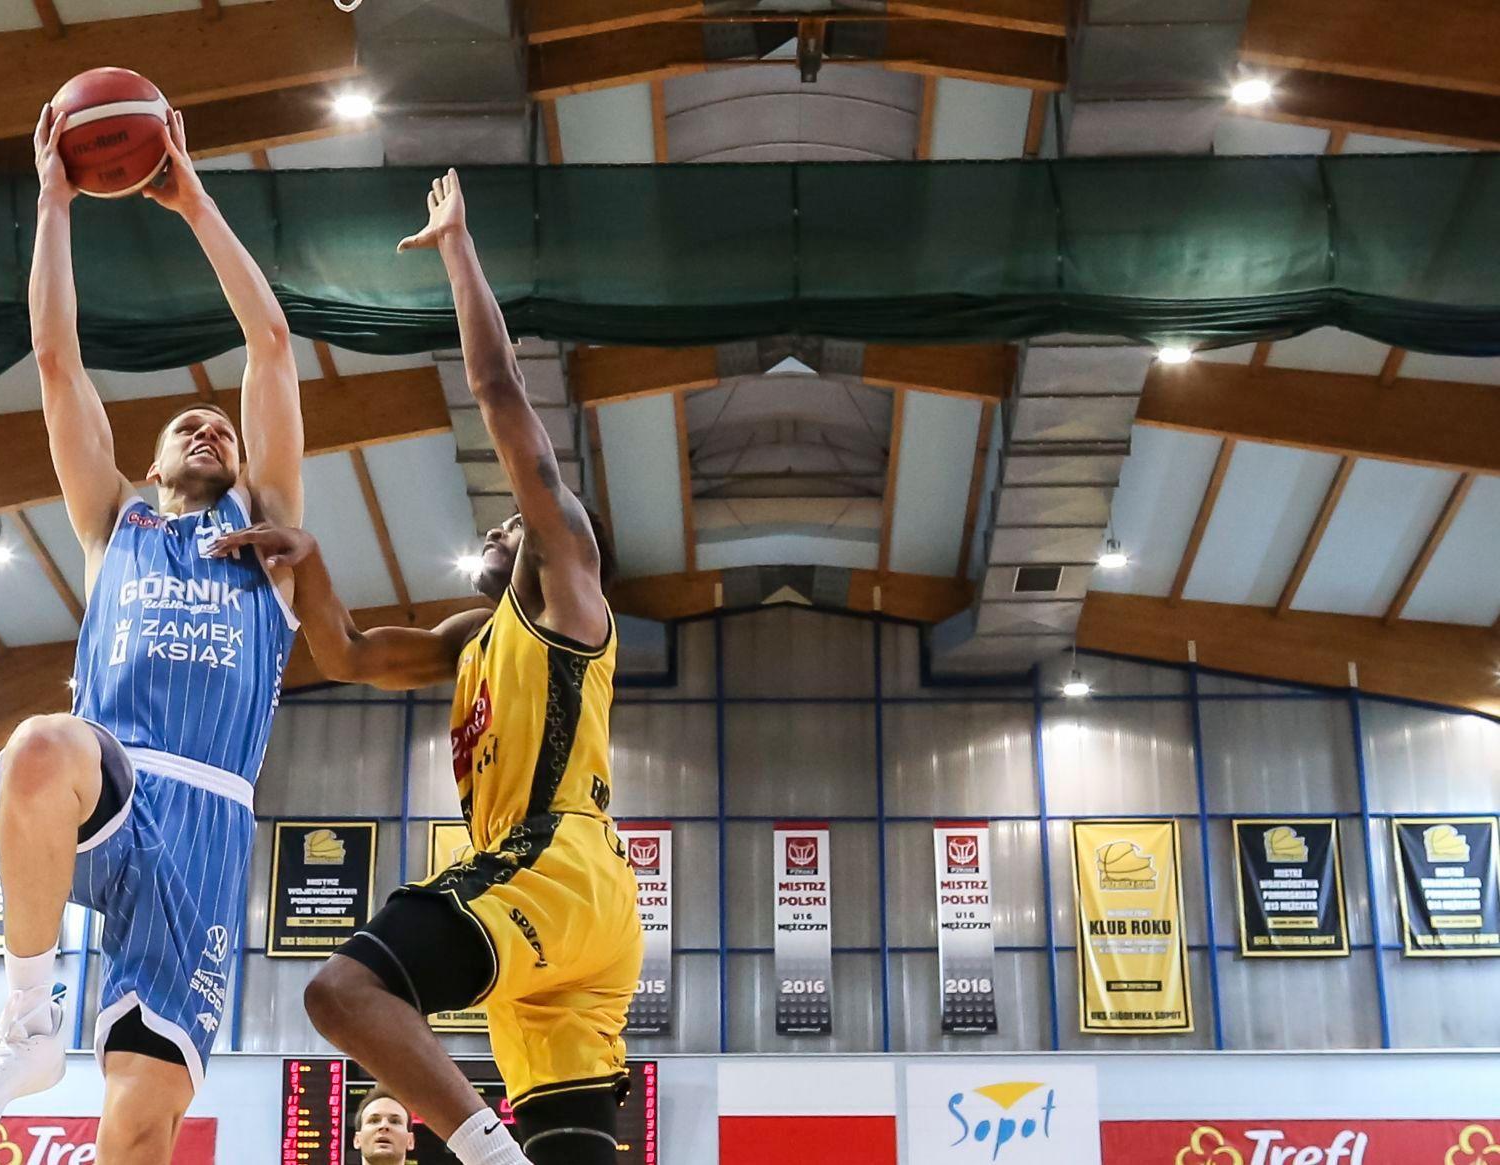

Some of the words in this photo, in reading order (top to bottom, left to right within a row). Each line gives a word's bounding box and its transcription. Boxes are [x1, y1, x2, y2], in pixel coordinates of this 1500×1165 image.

[120, 572, 242, 610] GÓRNIK
[141, 619, 243, 648] ZAMEK
[147, 641, 237, 668] KSIĄŻ
[637, 882, 668, 891] STRZ
[779, 882, 826, 891] MISTRZ
[941, 881, 988, 889] MISTRZ
[638, 897, 668, 906] LSKI
[779, 897, 827, 906] POLSKI
[941, 896, 989, 904] POLSKI
[942, 922, 991, 930] MĘŻCZYZN
[1090, 920, 1127, 935] KLUB
[1131, 920, 1171, 935] ROKU
[781, 980, 825, 994] 2016
[945, 979, 992, 994] 2018
[948, 1089, 1056, 1161] Sopot
[27, 1126, 97, 1165] Tre
[1244, 1129, 1369, 1165] Trefl
